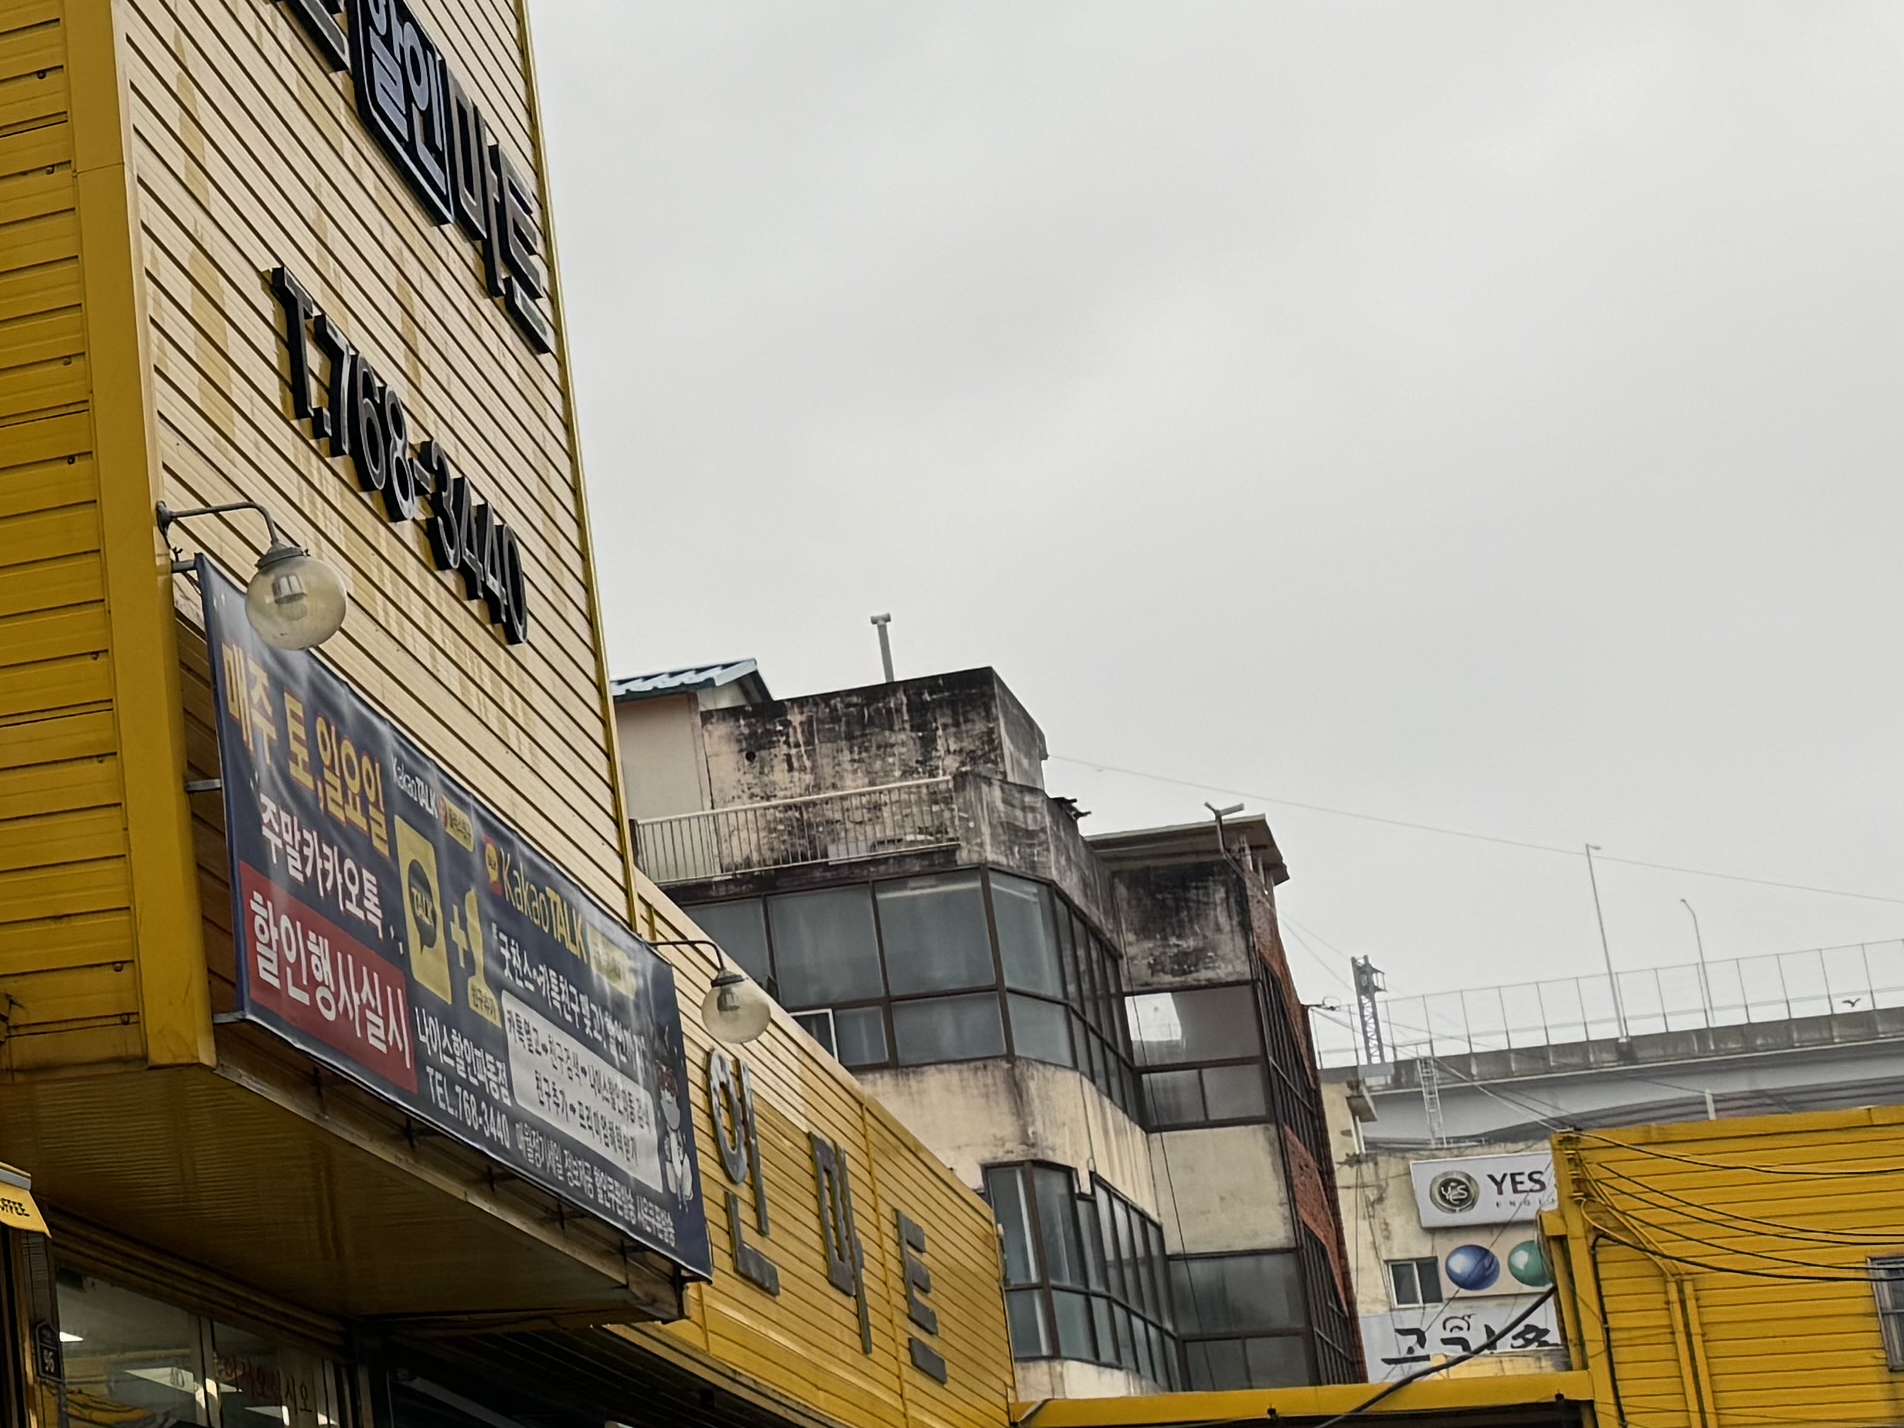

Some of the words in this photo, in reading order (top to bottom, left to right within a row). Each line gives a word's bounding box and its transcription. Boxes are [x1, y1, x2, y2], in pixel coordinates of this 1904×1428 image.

[221, 641, 278, 766] 매주
[283, 688, 391, 858] 토,일요일
[259, 792, 384, 940] 주말카카오톡
[500, 846, 588, 965] KakaoTALK
[250, 890, 412, 1070] 할인행사실시
[415, 1006, 513, 1107] 나이스할인파동점
[426, 1064, 511, 1150] TEL.768-3440
[1487, 1170, 1546, 1196] YES
